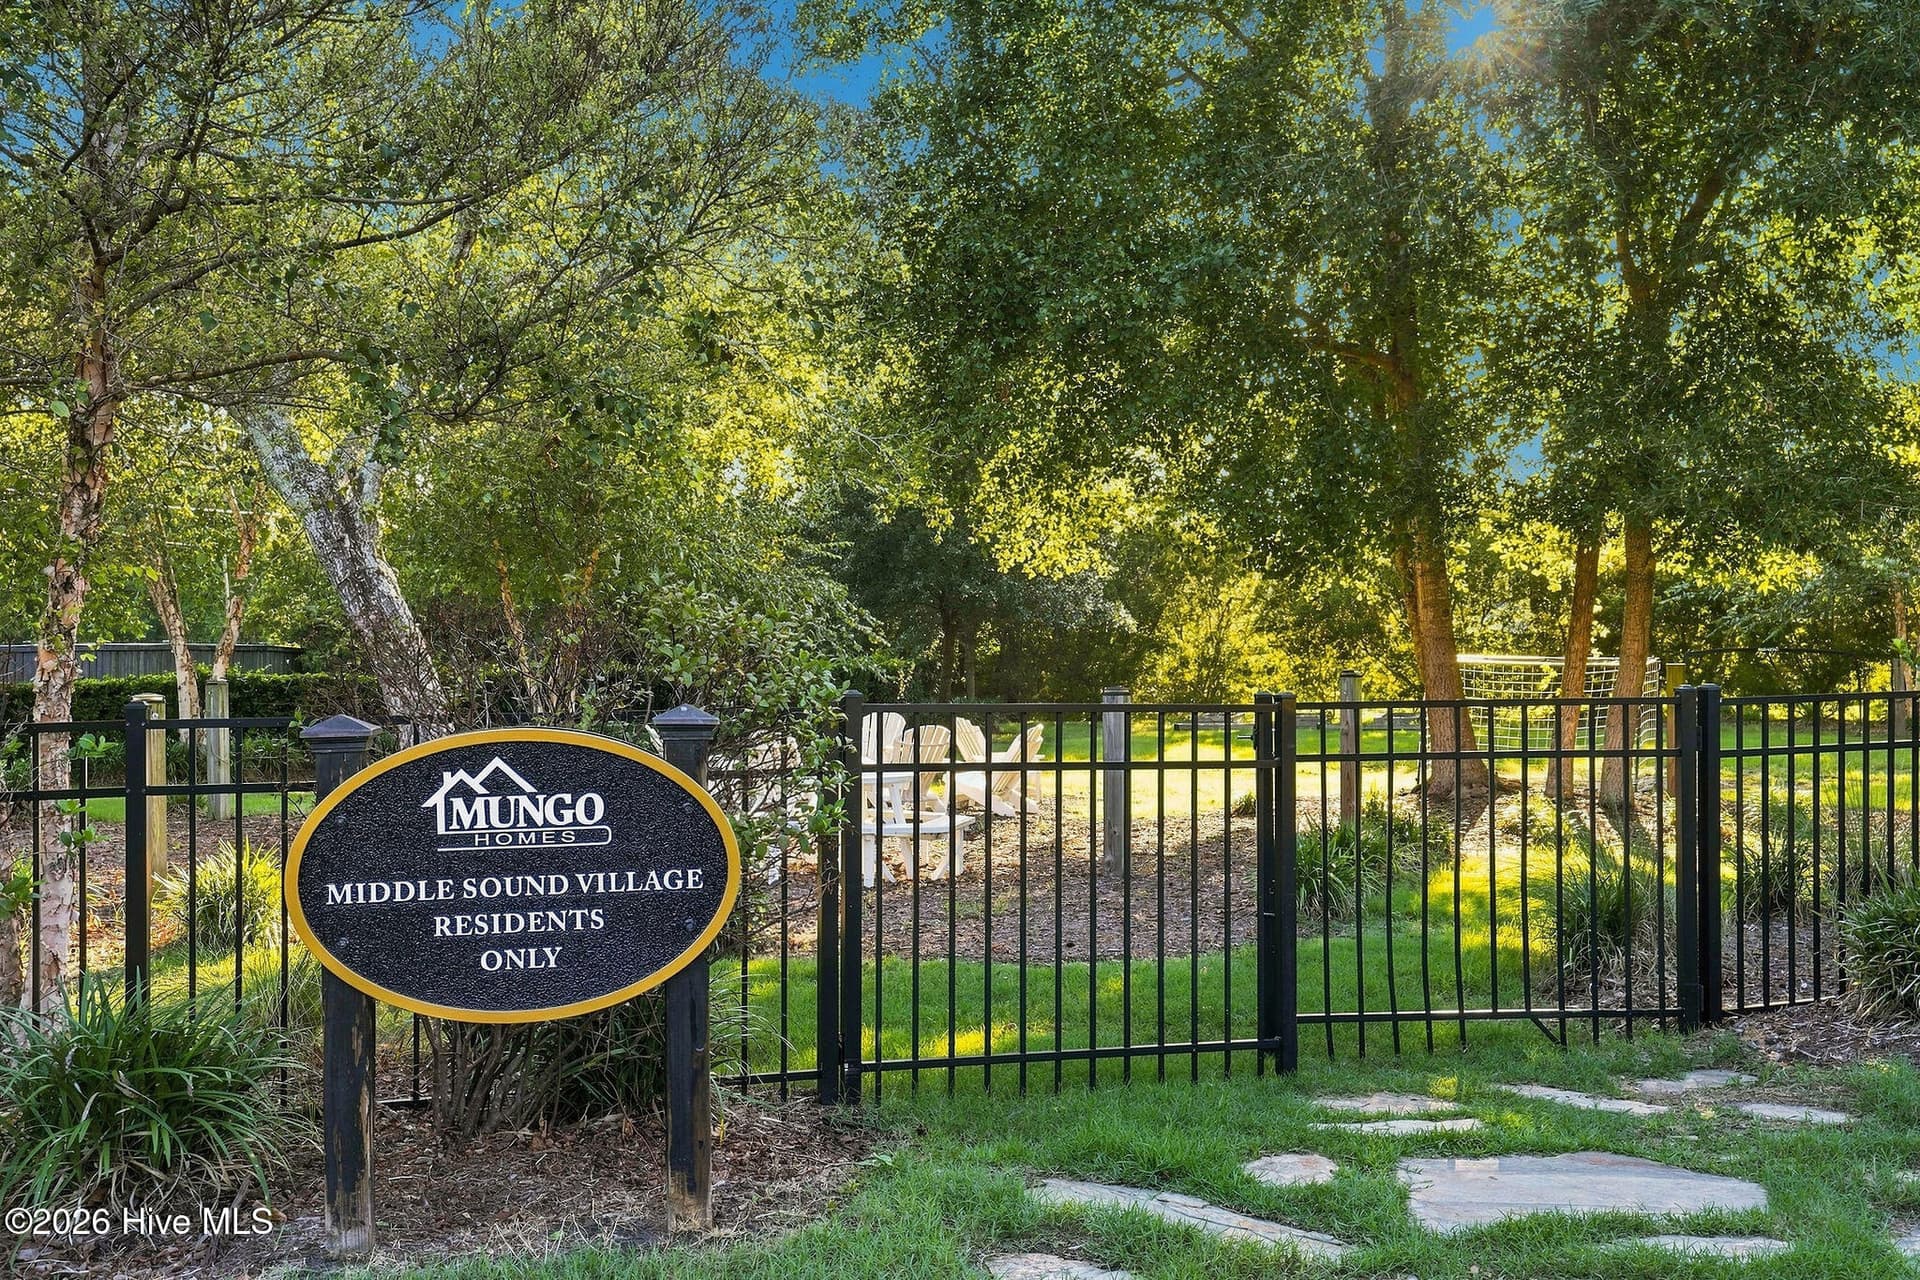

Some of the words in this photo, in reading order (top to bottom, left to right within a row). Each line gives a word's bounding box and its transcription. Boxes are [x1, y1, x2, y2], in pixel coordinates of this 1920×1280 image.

[448, 793, 605, 829] MUNGO
[474, 830, 576, 847] HOMES
[325, 879, 455, 905] MIDDLE
[461, 875, 570, 899] SOUND
[574, 868, 704, 894] VILLAGE
[433, 908, 605, 937] RESIDENTS
[480, 946, 563, 971] ONLY
